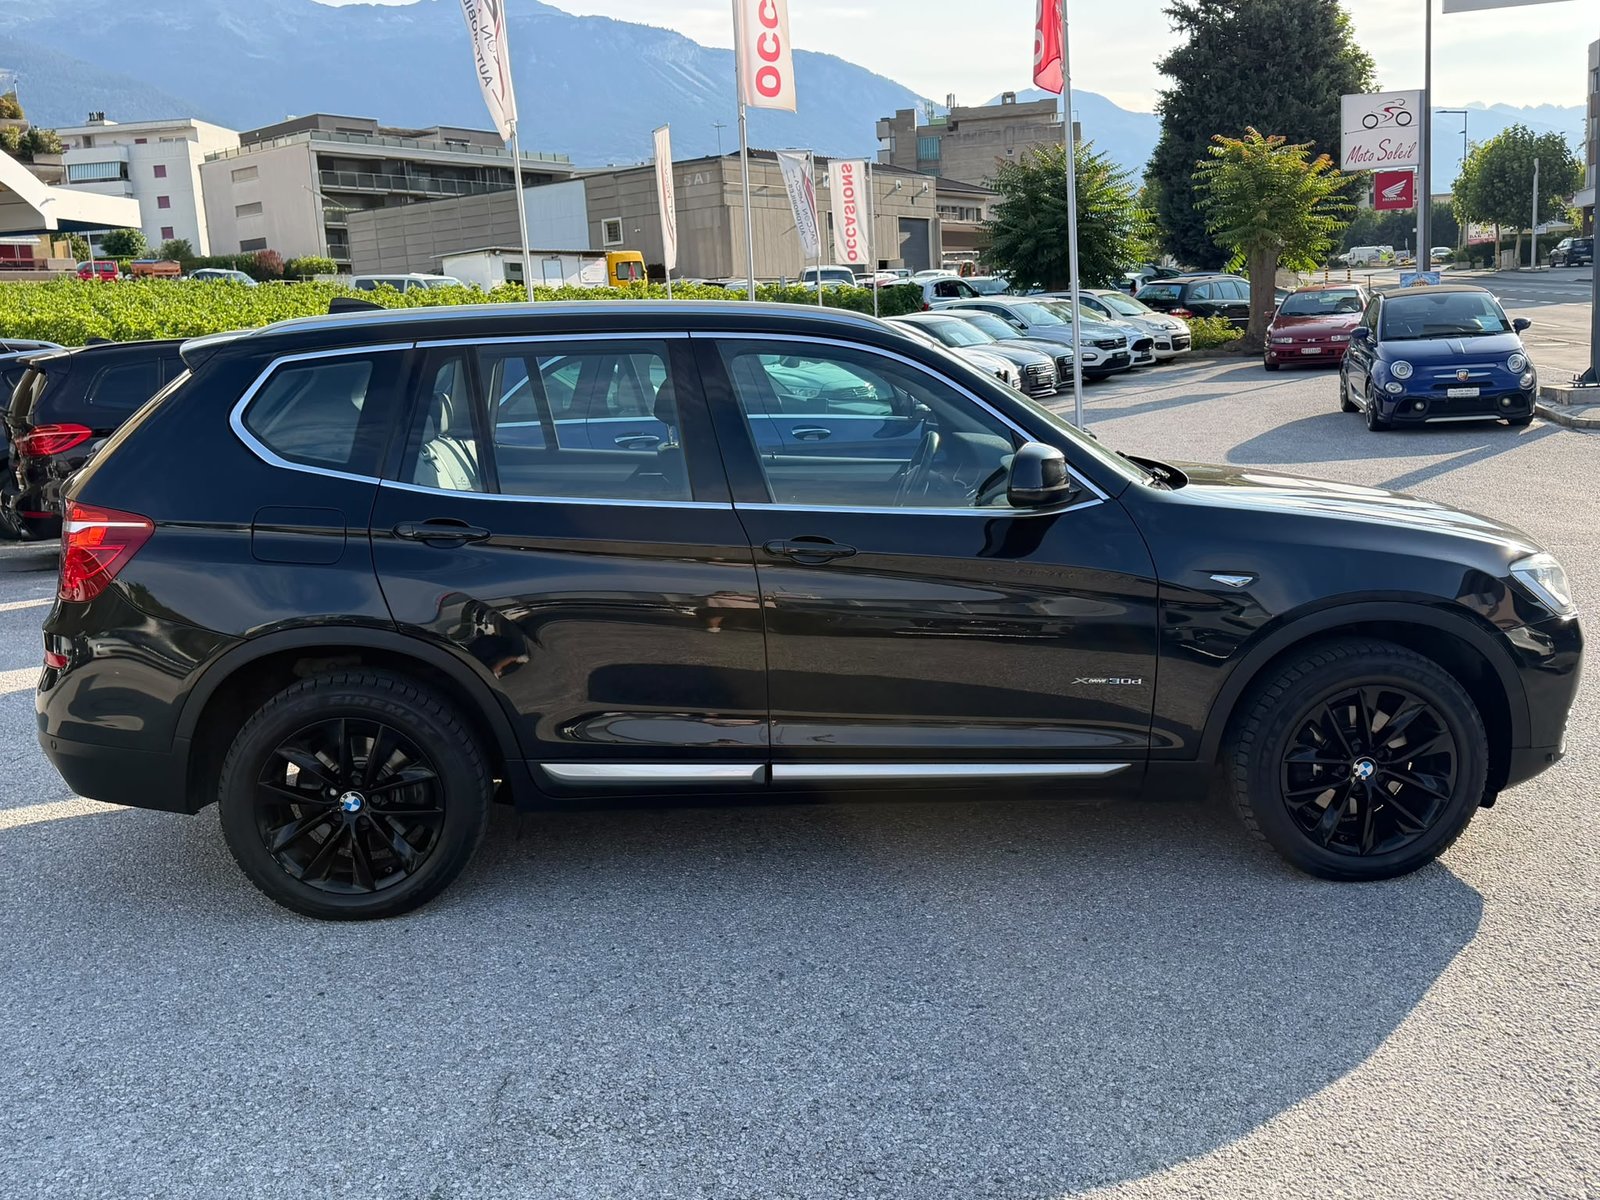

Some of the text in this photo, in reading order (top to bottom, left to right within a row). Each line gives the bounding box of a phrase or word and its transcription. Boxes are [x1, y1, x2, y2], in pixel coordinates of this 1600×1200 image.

[756, 0, 781, 98] OCC
[1345, 138, 1417, 165] Moto Soleil
